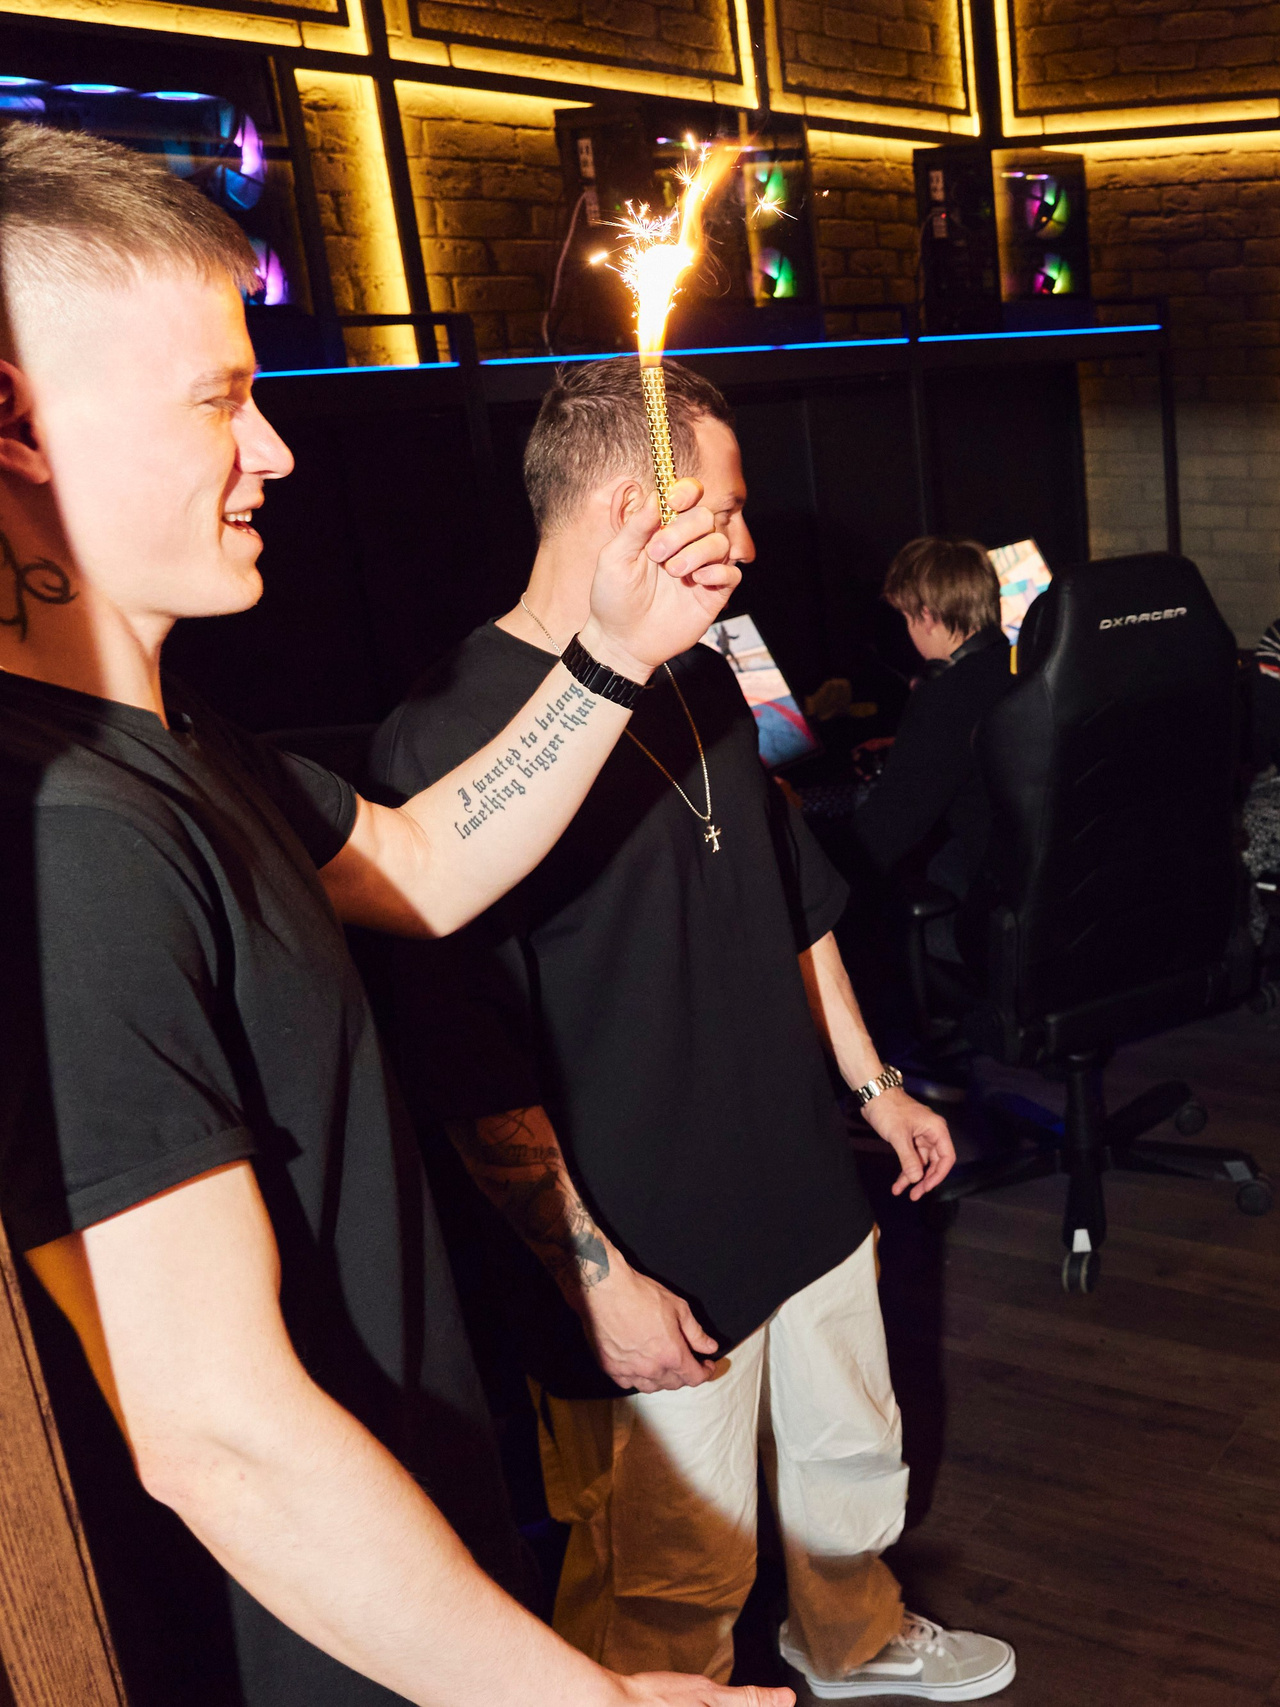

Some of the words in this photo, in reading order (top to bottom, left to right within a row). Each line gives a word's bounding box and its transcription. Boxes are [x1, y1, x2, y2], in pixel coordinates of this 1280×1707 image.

[1098, 606, 1188, 631] DXRACER
[457, 786, 472, 813] I
[472, 748, 521, 793] wanted
[519, 731, 538, 748] to
[534, 683, 584, 730] belong
[516, 733, 564, 778] bigger
[559, 698, 597, 732] than
